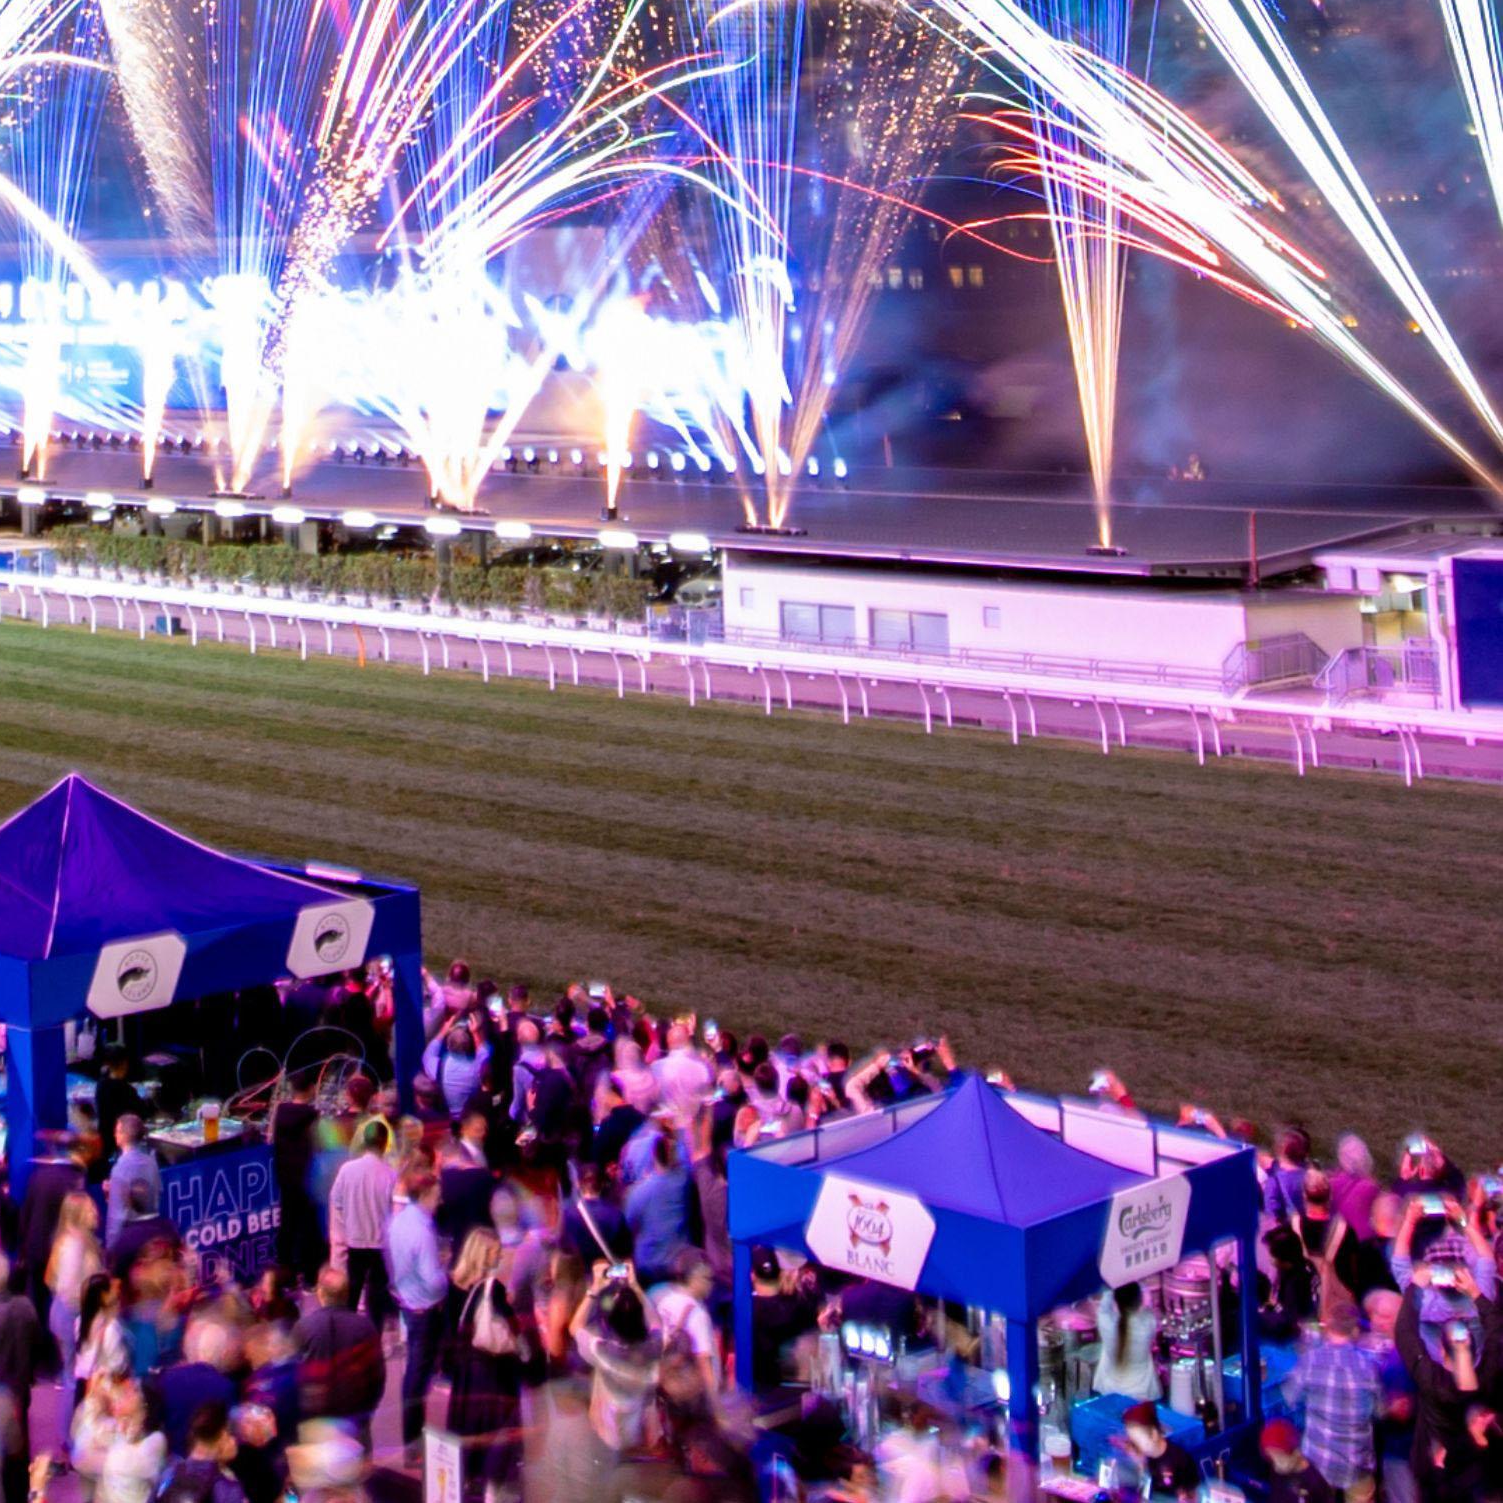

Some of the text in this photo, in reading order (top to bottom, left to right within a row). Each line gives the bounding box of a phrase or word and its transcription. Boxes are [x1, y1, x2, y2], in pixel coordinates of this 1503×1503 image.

[168, 1157, 275, 1227] HAP
[185, 1206, 282, 1250] COLD BEE
[1118, 1196, 1172, 1239] Carlsberg
[847, 1249, 895, 1277] BLANC
